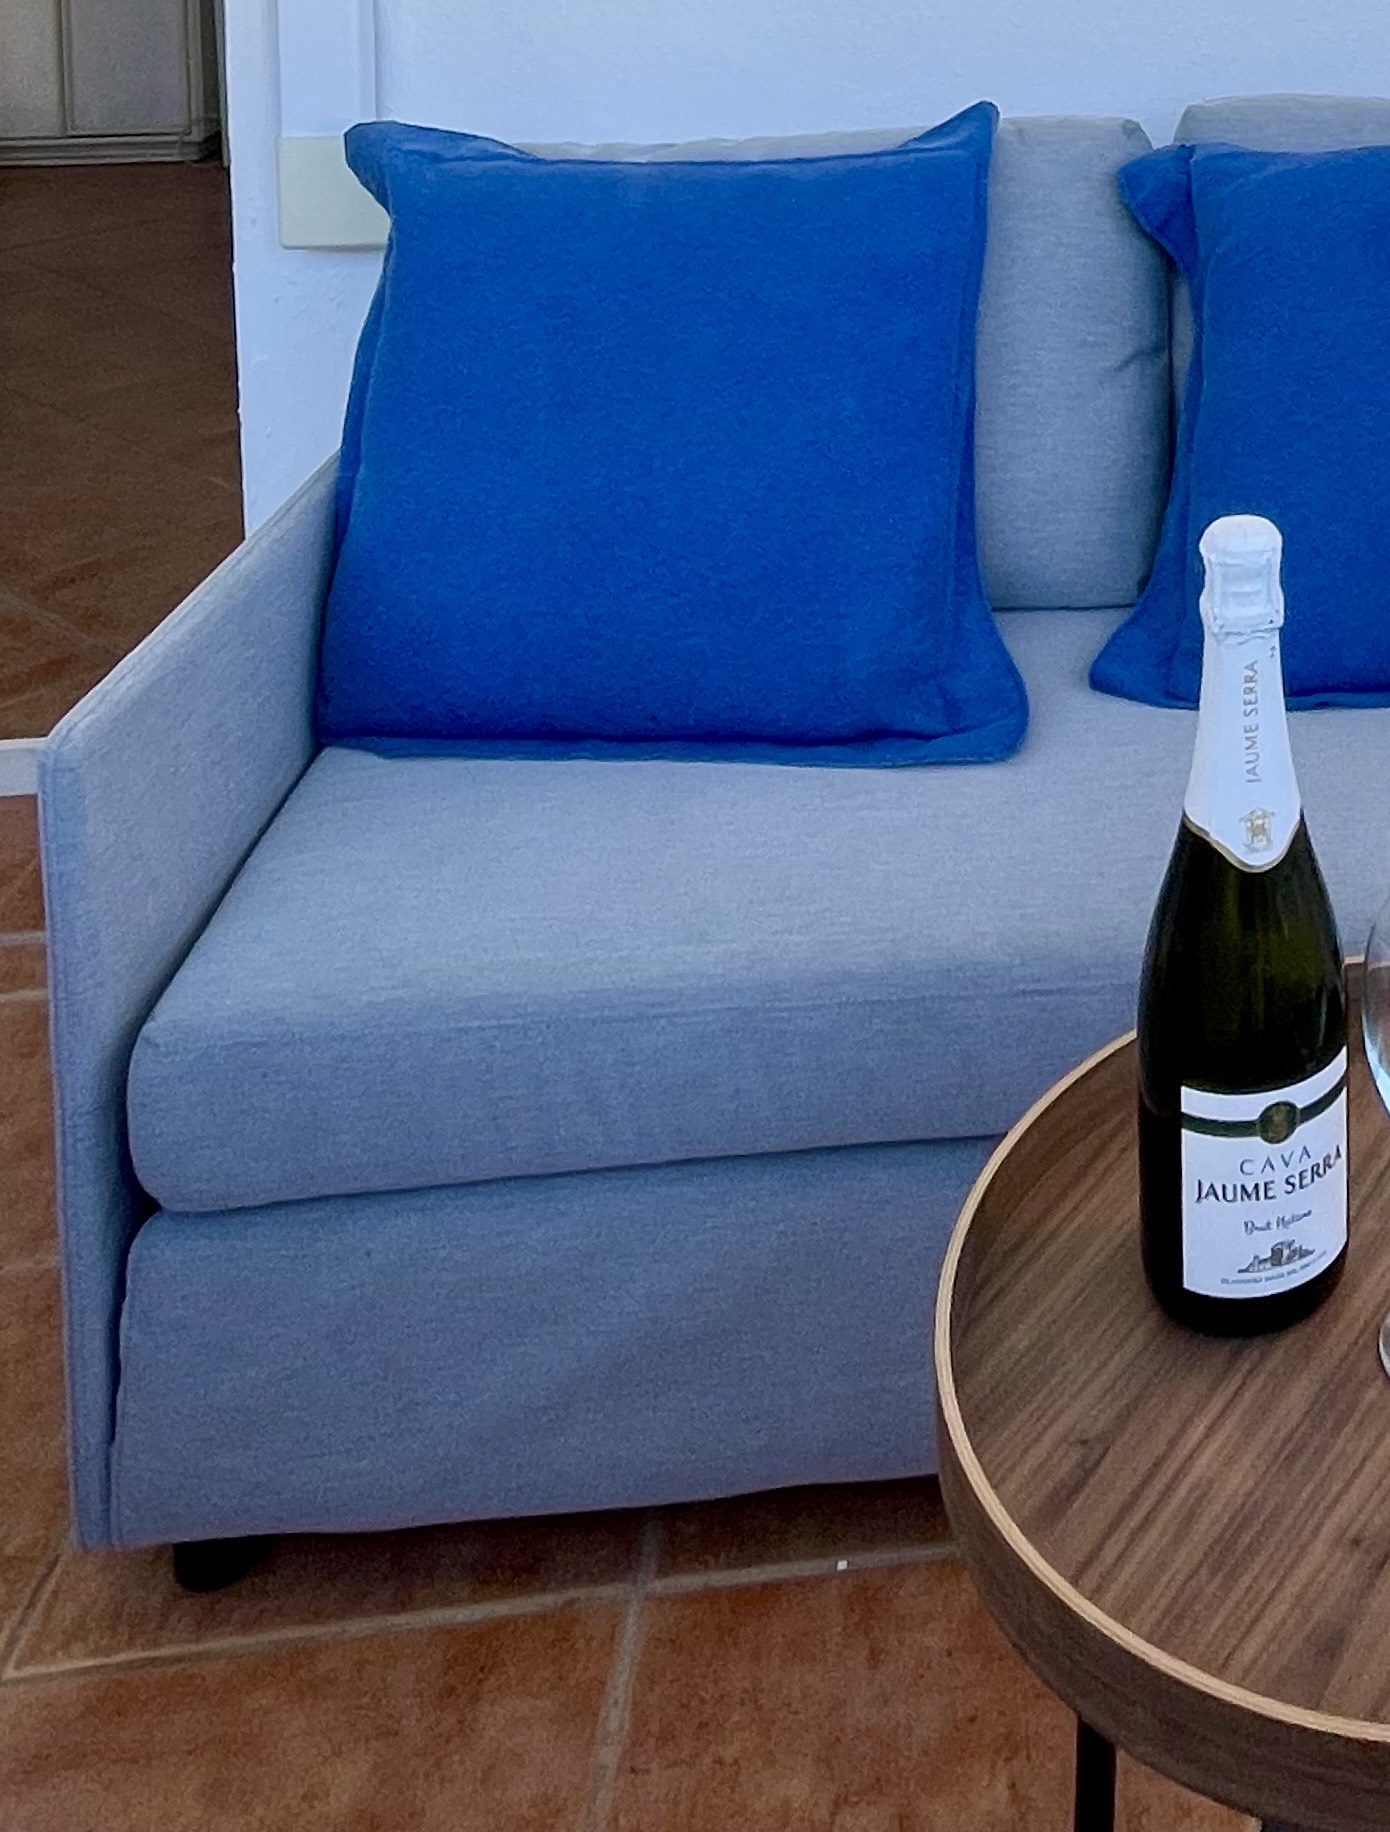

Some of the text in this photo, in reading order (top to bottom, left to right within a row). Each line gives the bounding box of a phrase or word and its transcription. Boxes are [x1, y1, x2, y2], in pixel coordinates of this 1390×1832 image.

[1243, 659, 1261, 784] JAUME SERRA
[1195, 1144, 1343, 1204] JAUME SERRA
[1239, 1145, 1312, 1176] CAVA
